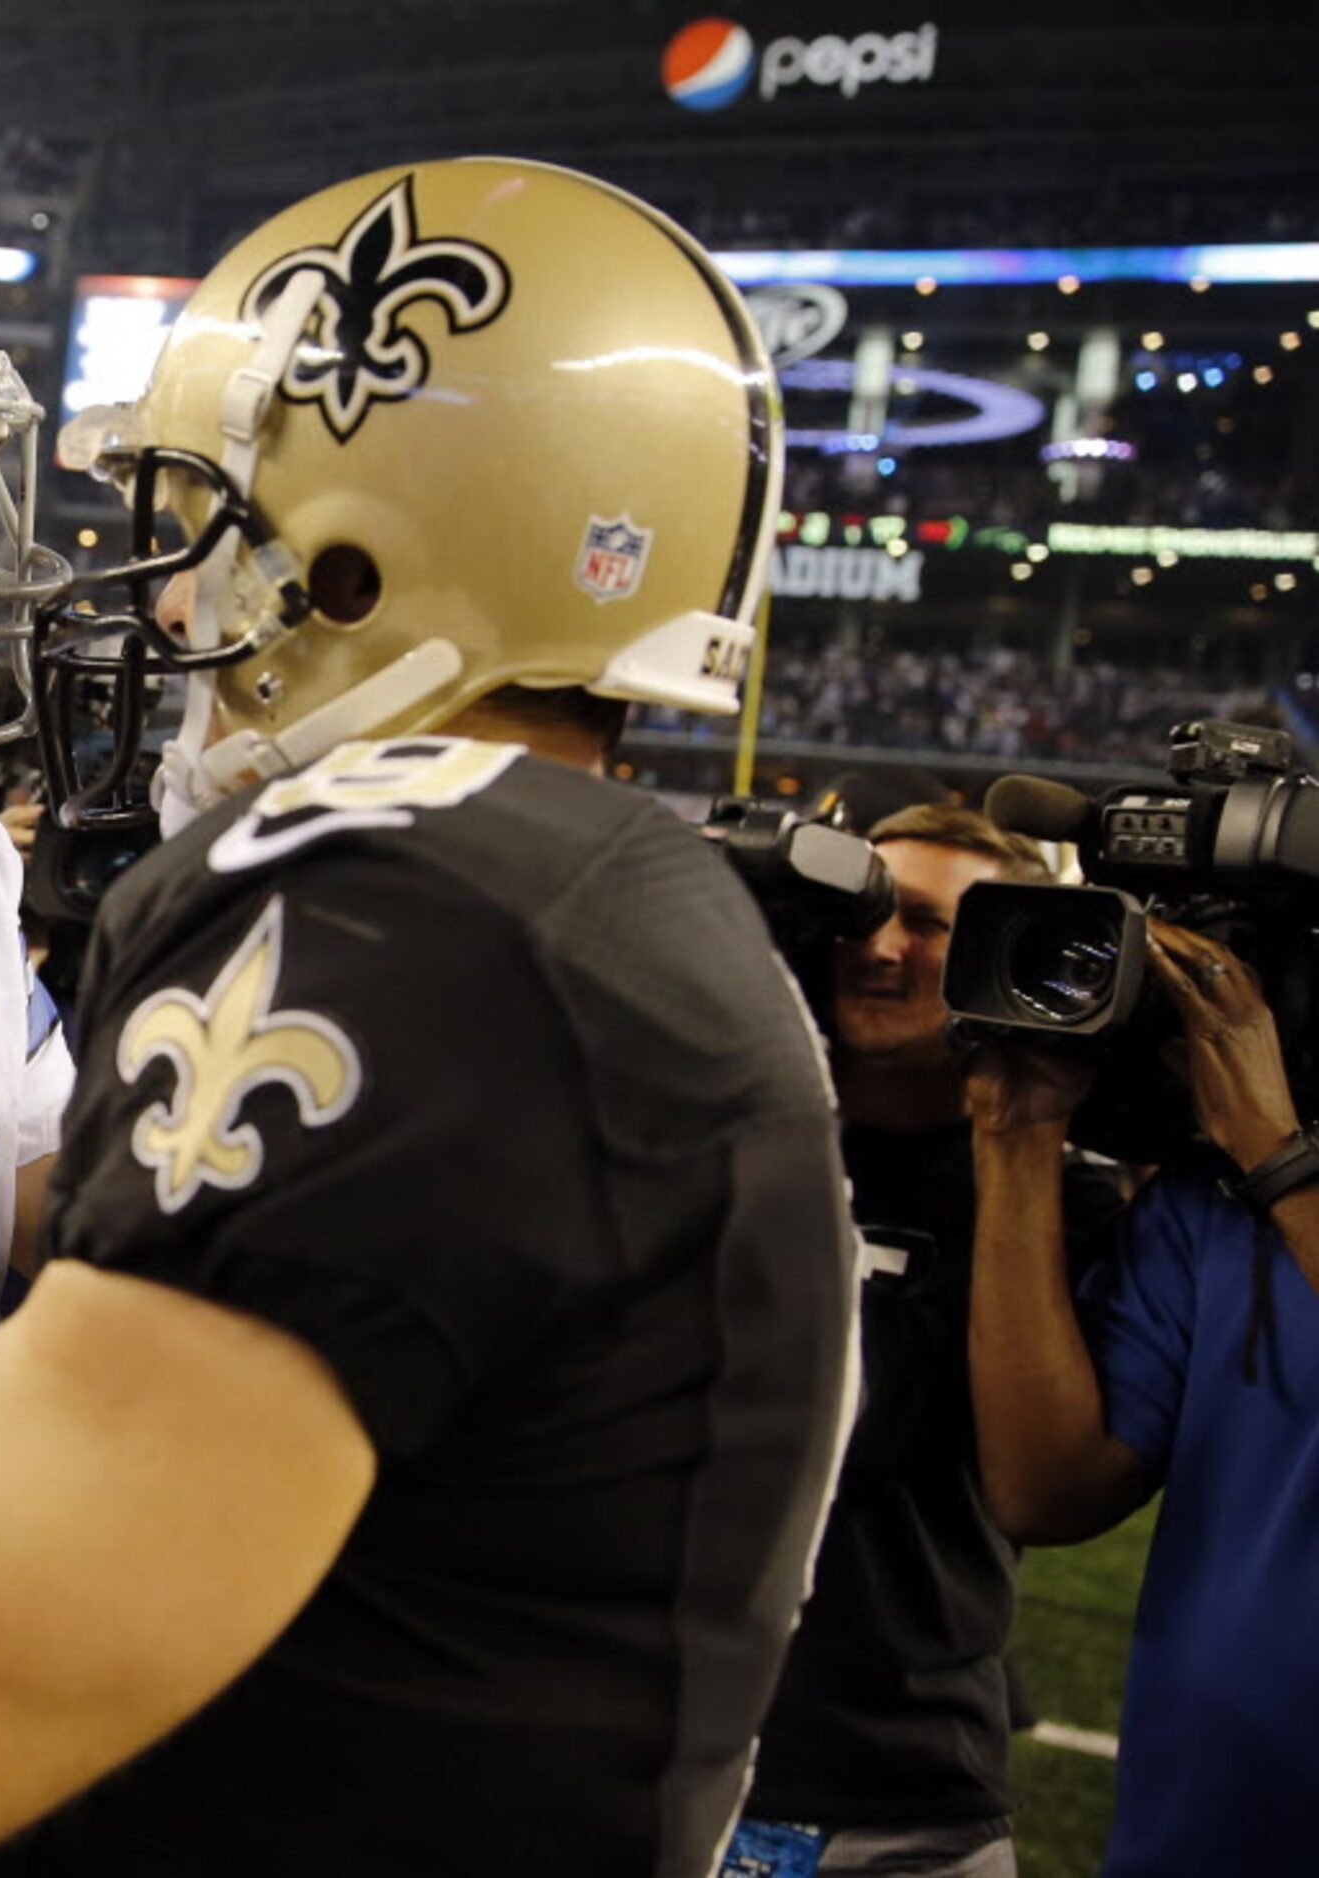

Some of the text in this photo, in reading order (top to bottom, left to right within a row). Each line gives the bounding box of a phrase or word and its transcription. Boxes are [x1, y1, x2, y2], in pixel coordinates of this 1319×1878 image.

[760, 22, 937, 101] pepsi
[581, 549, 632, 592] NFL
[770, 545, 924, 603] ADIUM
